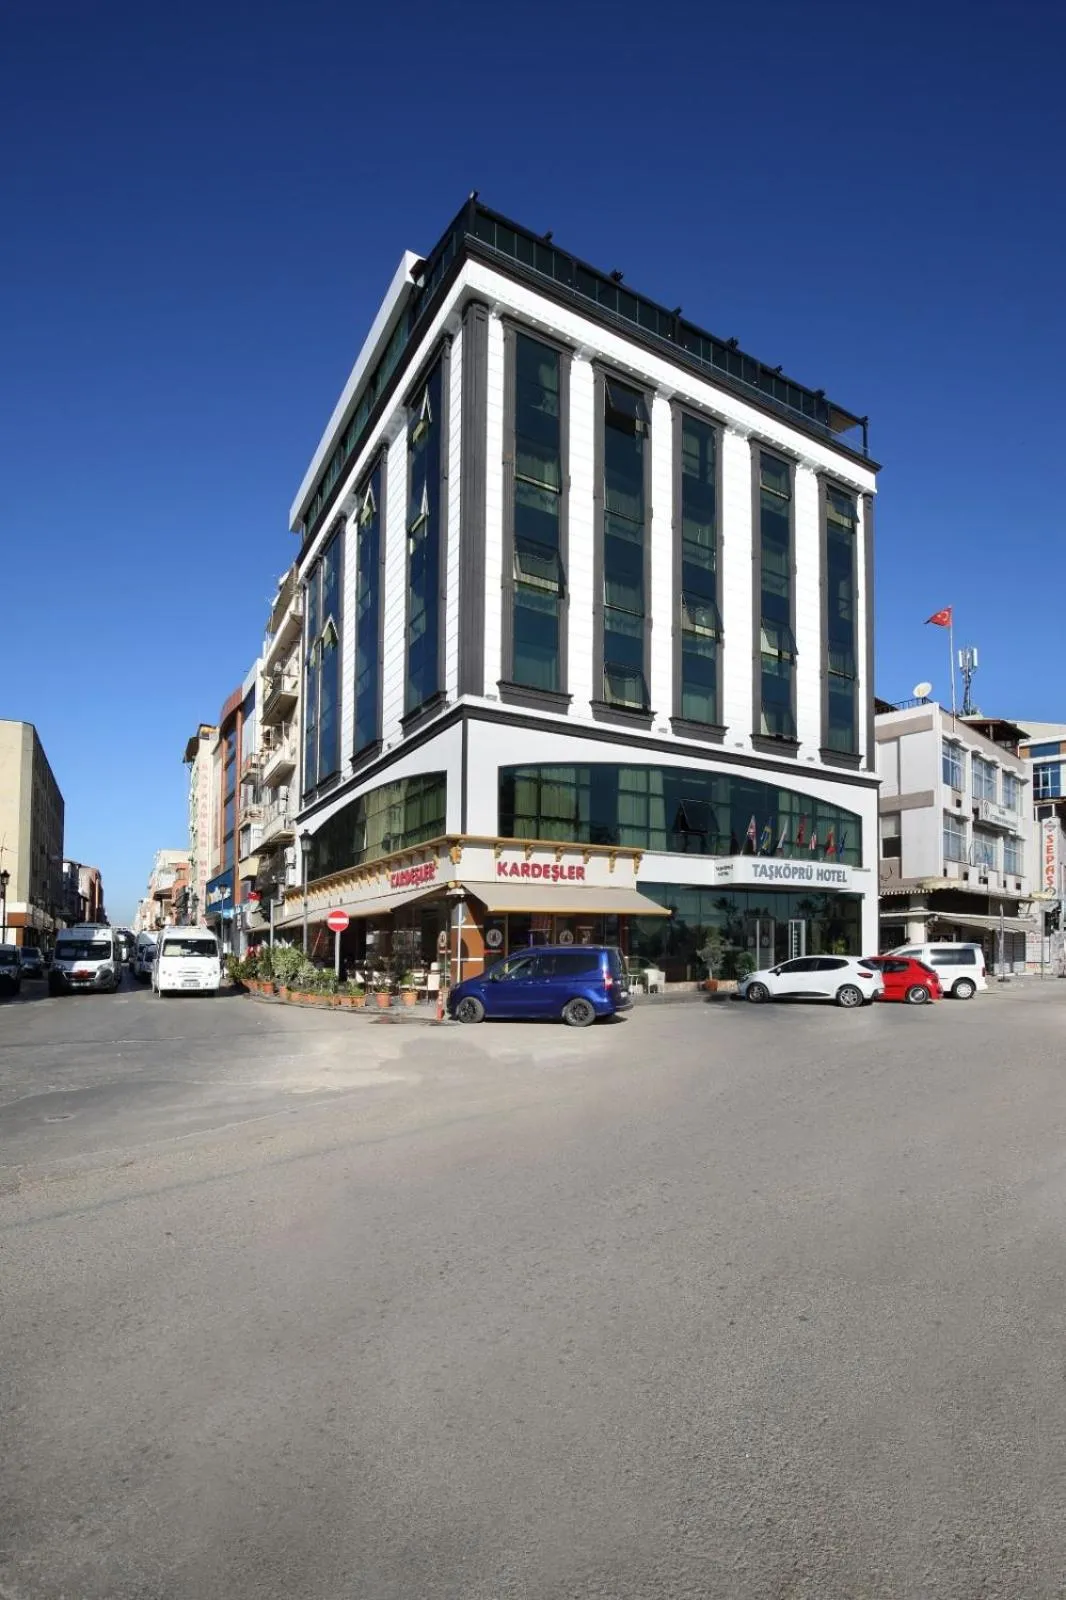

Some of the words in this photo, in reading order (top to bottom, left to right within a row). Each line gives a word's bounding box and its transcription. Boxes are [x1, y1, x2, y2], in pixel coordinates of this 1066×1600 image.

[497, 861, 585, 882] KARDEŞLER
[752, 863, 813, 880] TAŞKÖPRÜ
[816, 869, 847, 882] HOTEL
